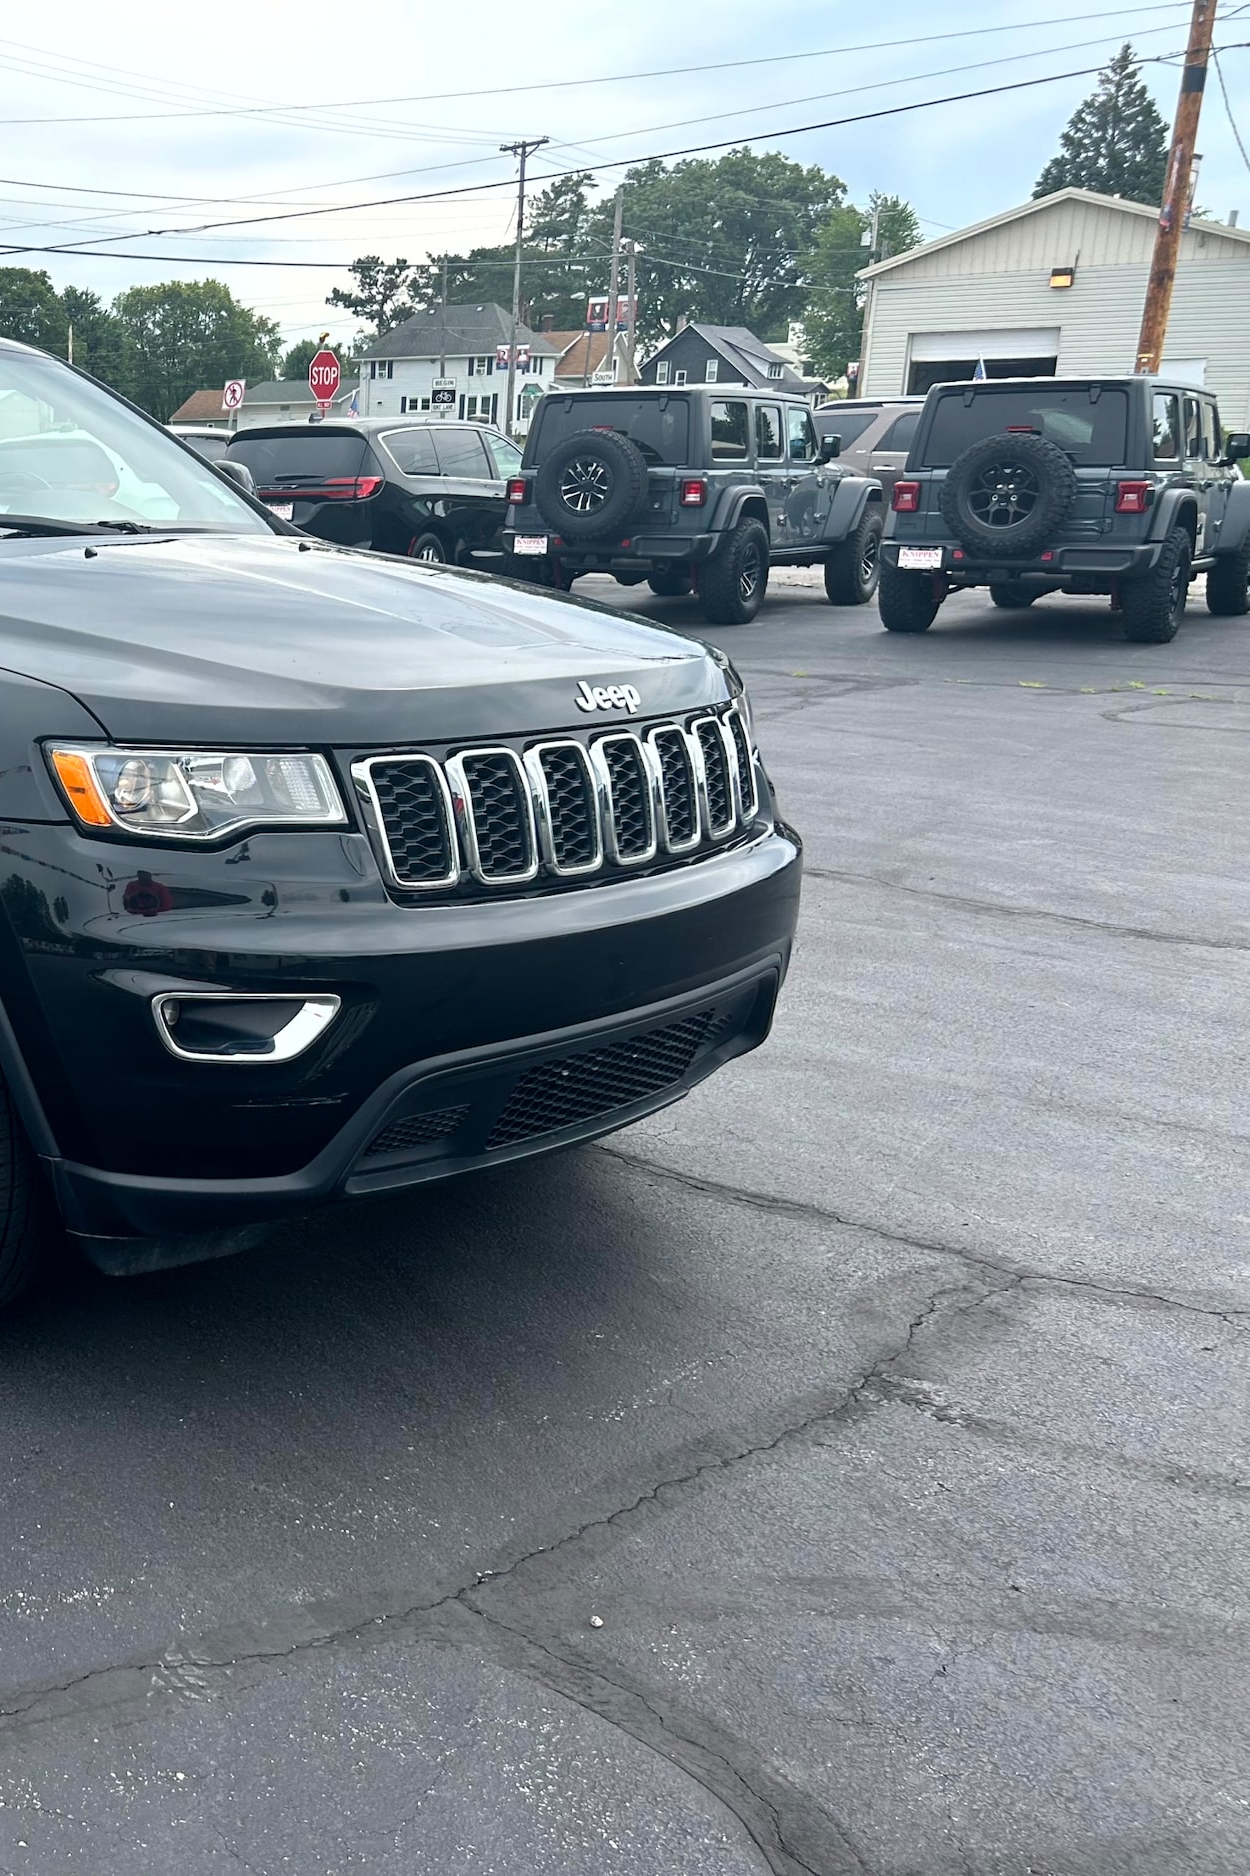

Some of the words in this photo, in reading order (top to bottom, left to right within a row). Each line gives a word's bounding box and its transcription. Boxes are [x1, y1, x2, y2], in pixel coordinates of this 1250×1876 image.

[311, 366, 338, 386] STOP
[902, 550, 939, 558] KNIPPEN
[574, 680, 642, 715] Jeep
